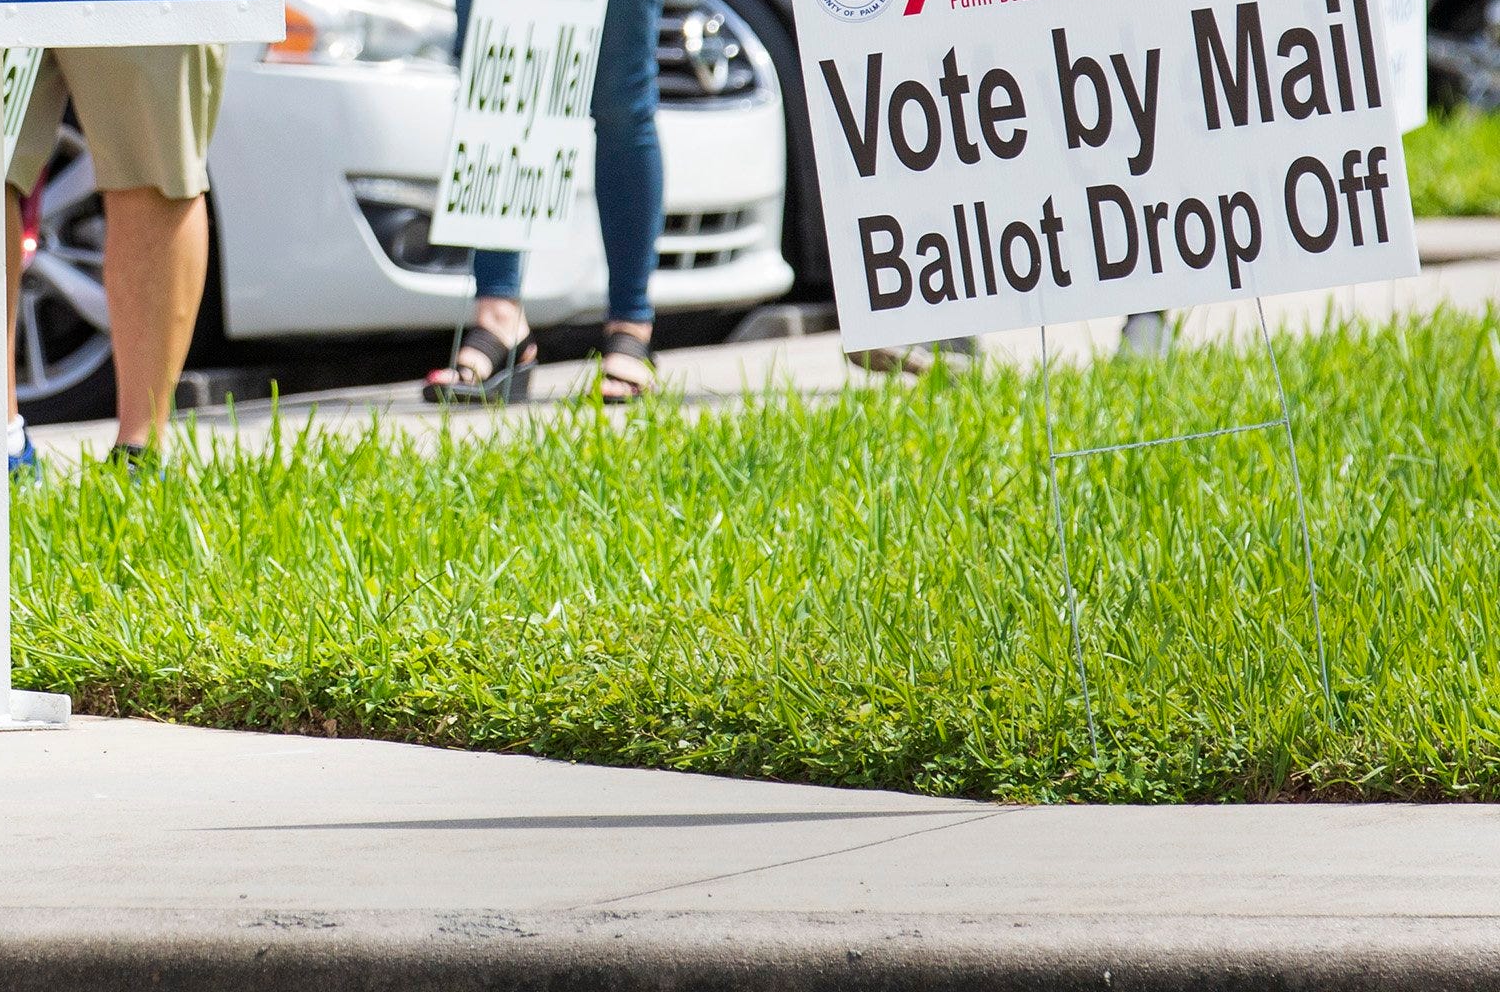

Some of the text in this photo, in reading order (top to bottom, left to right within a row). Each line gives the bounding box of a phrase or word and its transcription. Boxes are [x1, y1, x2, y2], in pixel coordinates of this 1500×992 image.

[843, 9, 854, 17] OF
[860, 2, 880, 16] PALM
[468, 18, 601, 143] Vote by Mail
[819, 45, 1028, 178] Vote
[1051, 28, 1161, 177] by
[447, 141, 579, 240] Ballot Drop Off
[858, 146, 1390, 312] Ballot Drop Off
